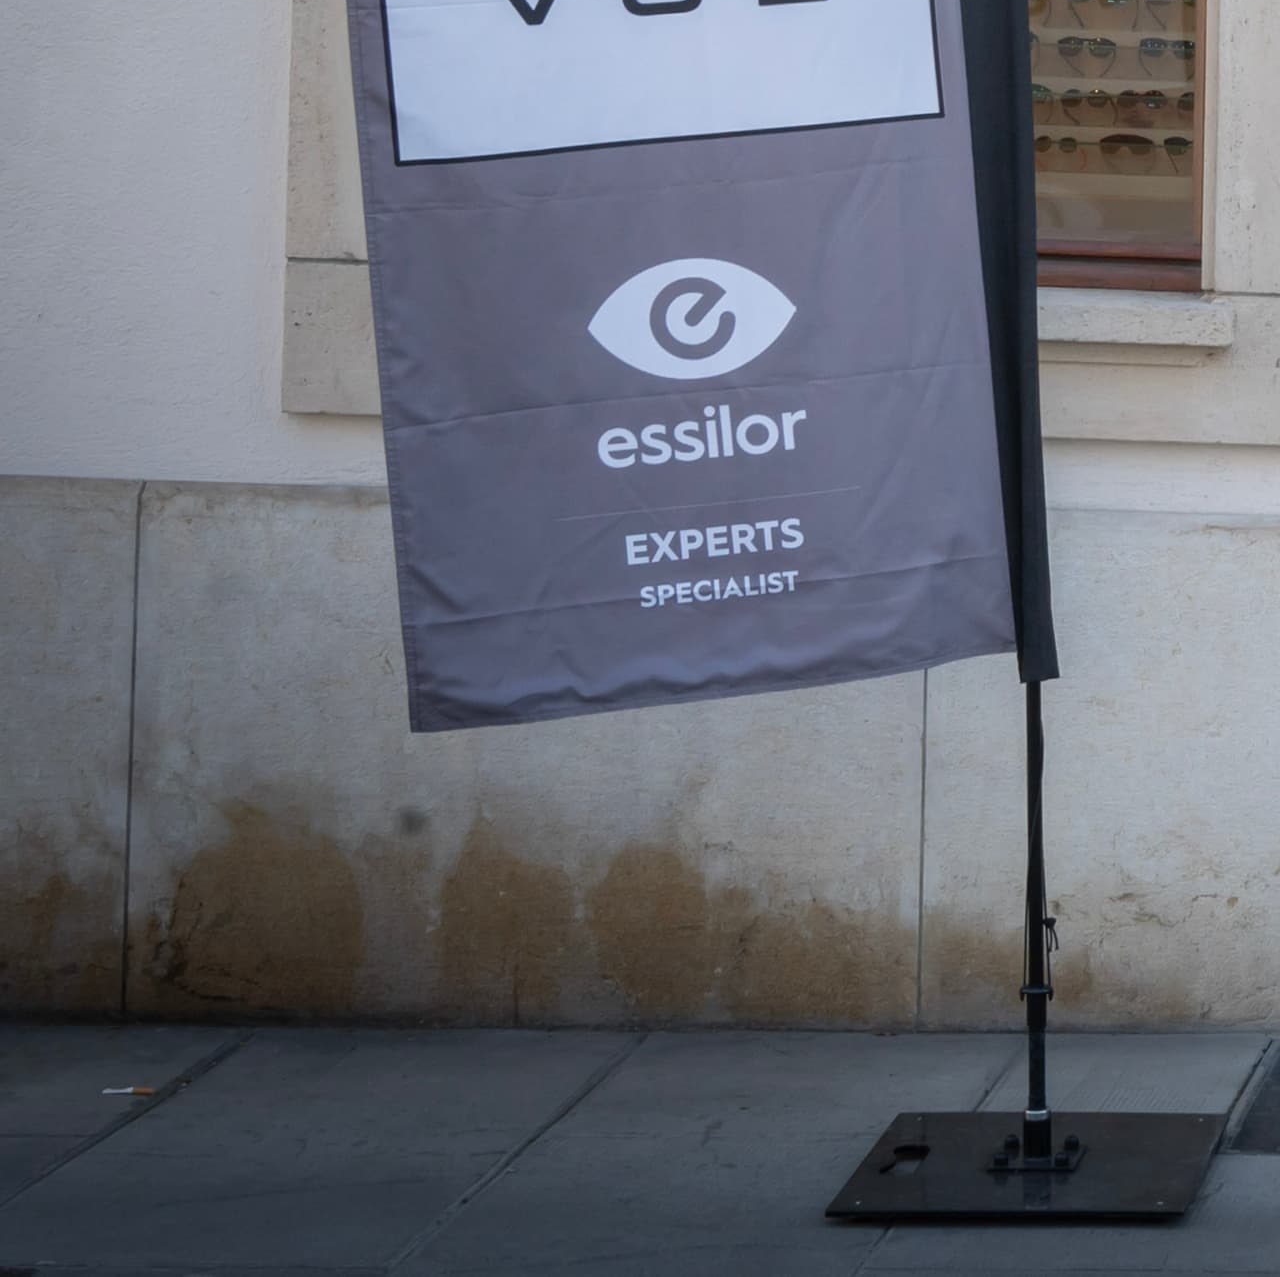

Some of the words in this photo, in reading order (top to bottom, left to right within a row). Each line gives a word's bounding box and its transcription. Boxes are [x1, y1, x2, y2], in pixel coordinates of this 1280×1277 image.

[597, 405, 807, 469] essilor
[624, 517, 805, 566] EXPERTS
[639, 570, 800, 609] SPECIALIST
